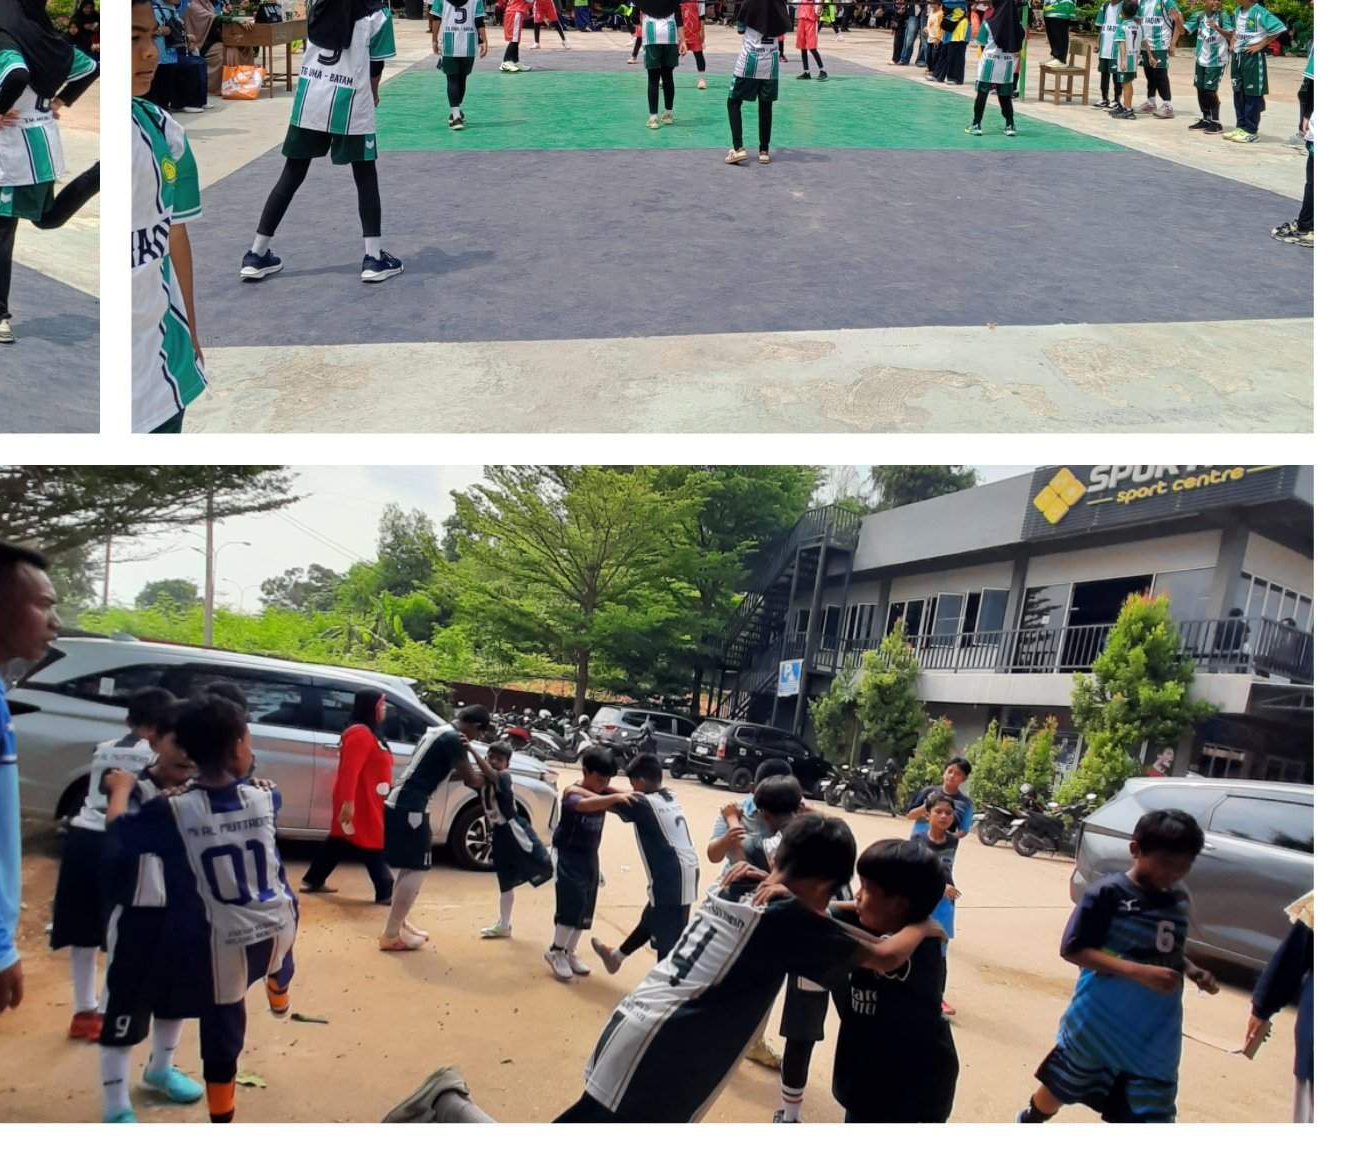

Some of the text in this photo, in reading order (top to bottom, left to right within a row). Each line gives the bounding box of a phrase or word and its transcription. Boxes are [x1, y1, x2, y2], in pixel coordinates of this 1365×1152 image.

[1131, 30, 1138, 49] 7
[329, 73, 354, 86] BATAM
[1116, 466, 1245, 504] sport centre
[200, 838, 278, 906] 01
[1155, 920, 1176, 953] 6
[114, 1015, 132, 1038] 9
